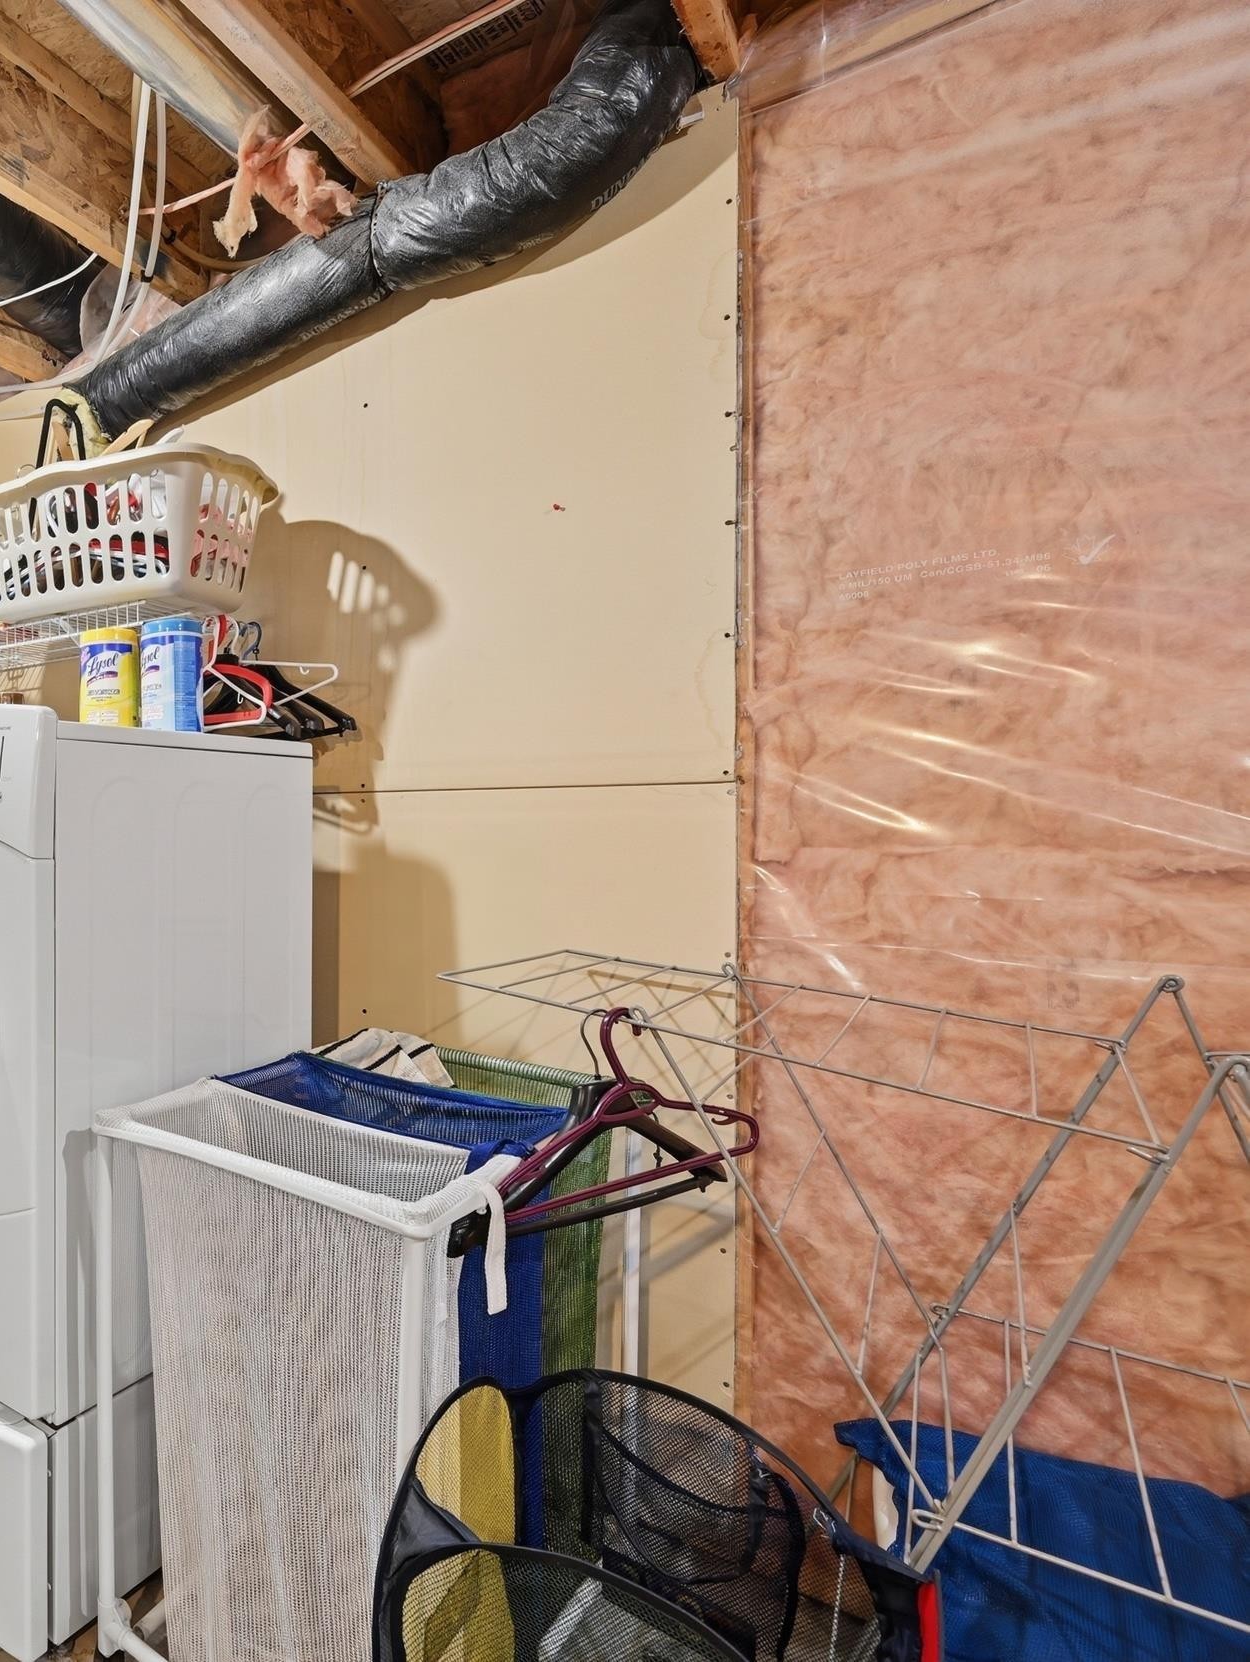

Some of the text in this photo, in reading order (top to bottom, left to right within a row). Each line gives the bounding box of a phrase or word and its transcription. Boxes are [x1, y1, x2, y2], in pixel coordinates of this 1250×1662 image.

[838, 548, 1001, 581] LAYFIELD POLY FILMS LTD.
[894, 573, 912, 583] UM
[87, 652, 119, 677] Lysol
